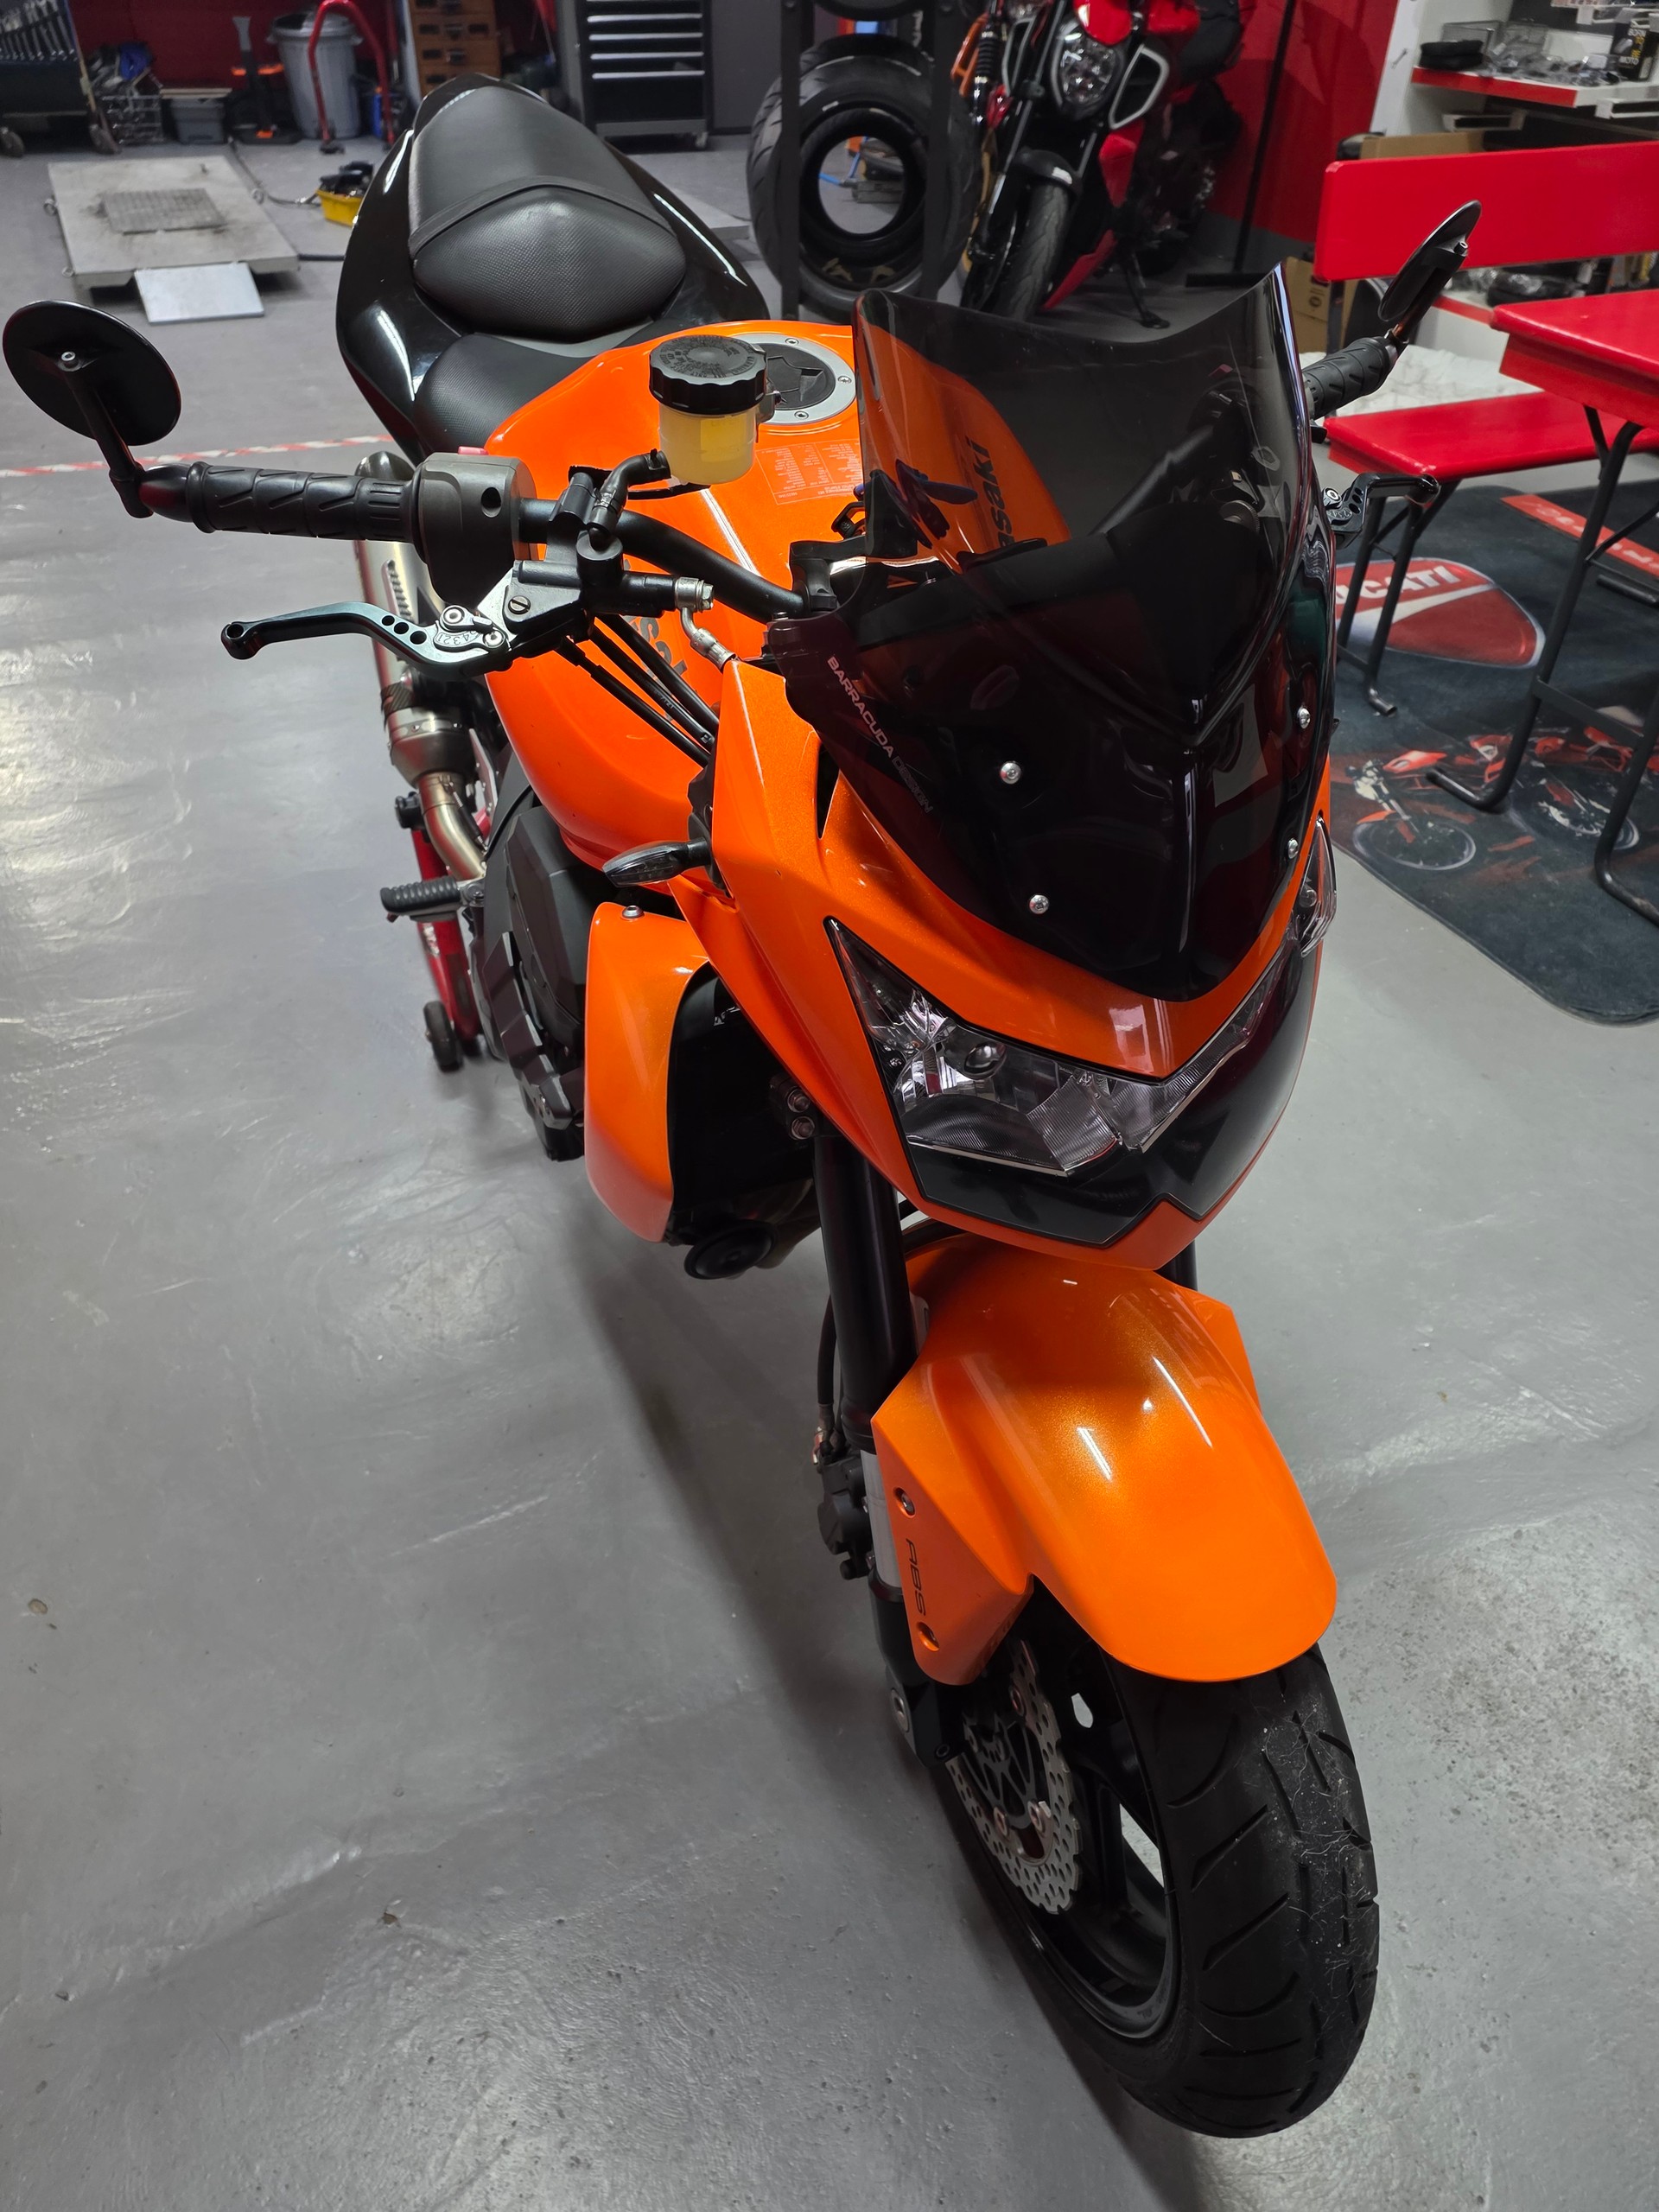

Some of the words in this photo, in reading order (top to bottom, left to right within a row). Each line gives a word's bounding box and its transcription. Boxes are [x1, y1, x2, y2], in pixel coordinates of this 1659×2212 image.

[827, 656, 894, 758] BARRACUDA
[892, 755, 934, 813] DESIGN
[906, 1538, 926, 1616] ABS
